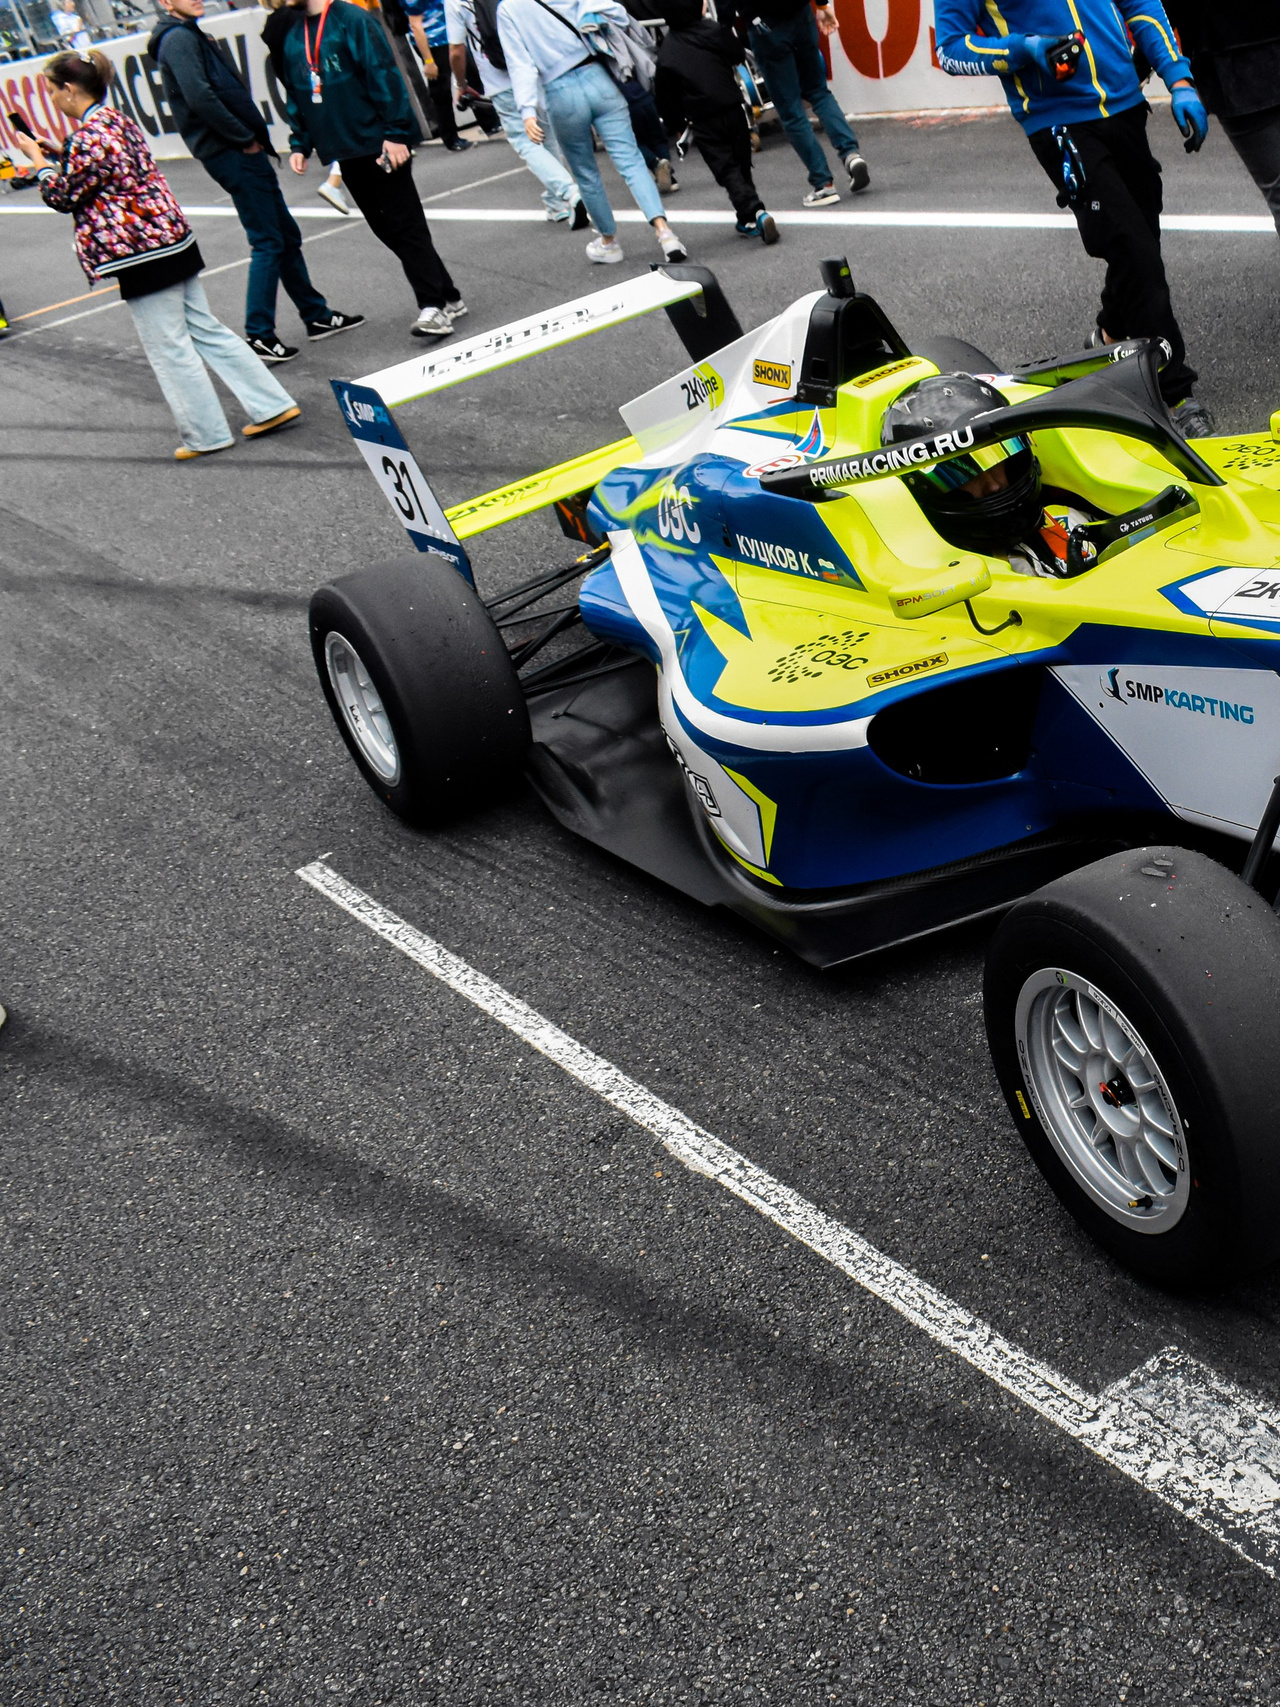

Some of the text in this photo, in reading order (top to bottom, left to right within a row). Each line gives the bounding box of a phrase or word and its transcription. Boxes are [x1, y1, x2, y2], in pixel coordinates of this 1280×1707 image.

[680, 374, 718, 410] 2Kline
[754, 364, 789, 385] SHONX
[809, 425, 975, 487] PRIMARACING.RU
[382, 456, 429, 526] 31
[736, 534, 818, 577] КУЦКОВ К.
[871, 656, 944, 684] SHONX
